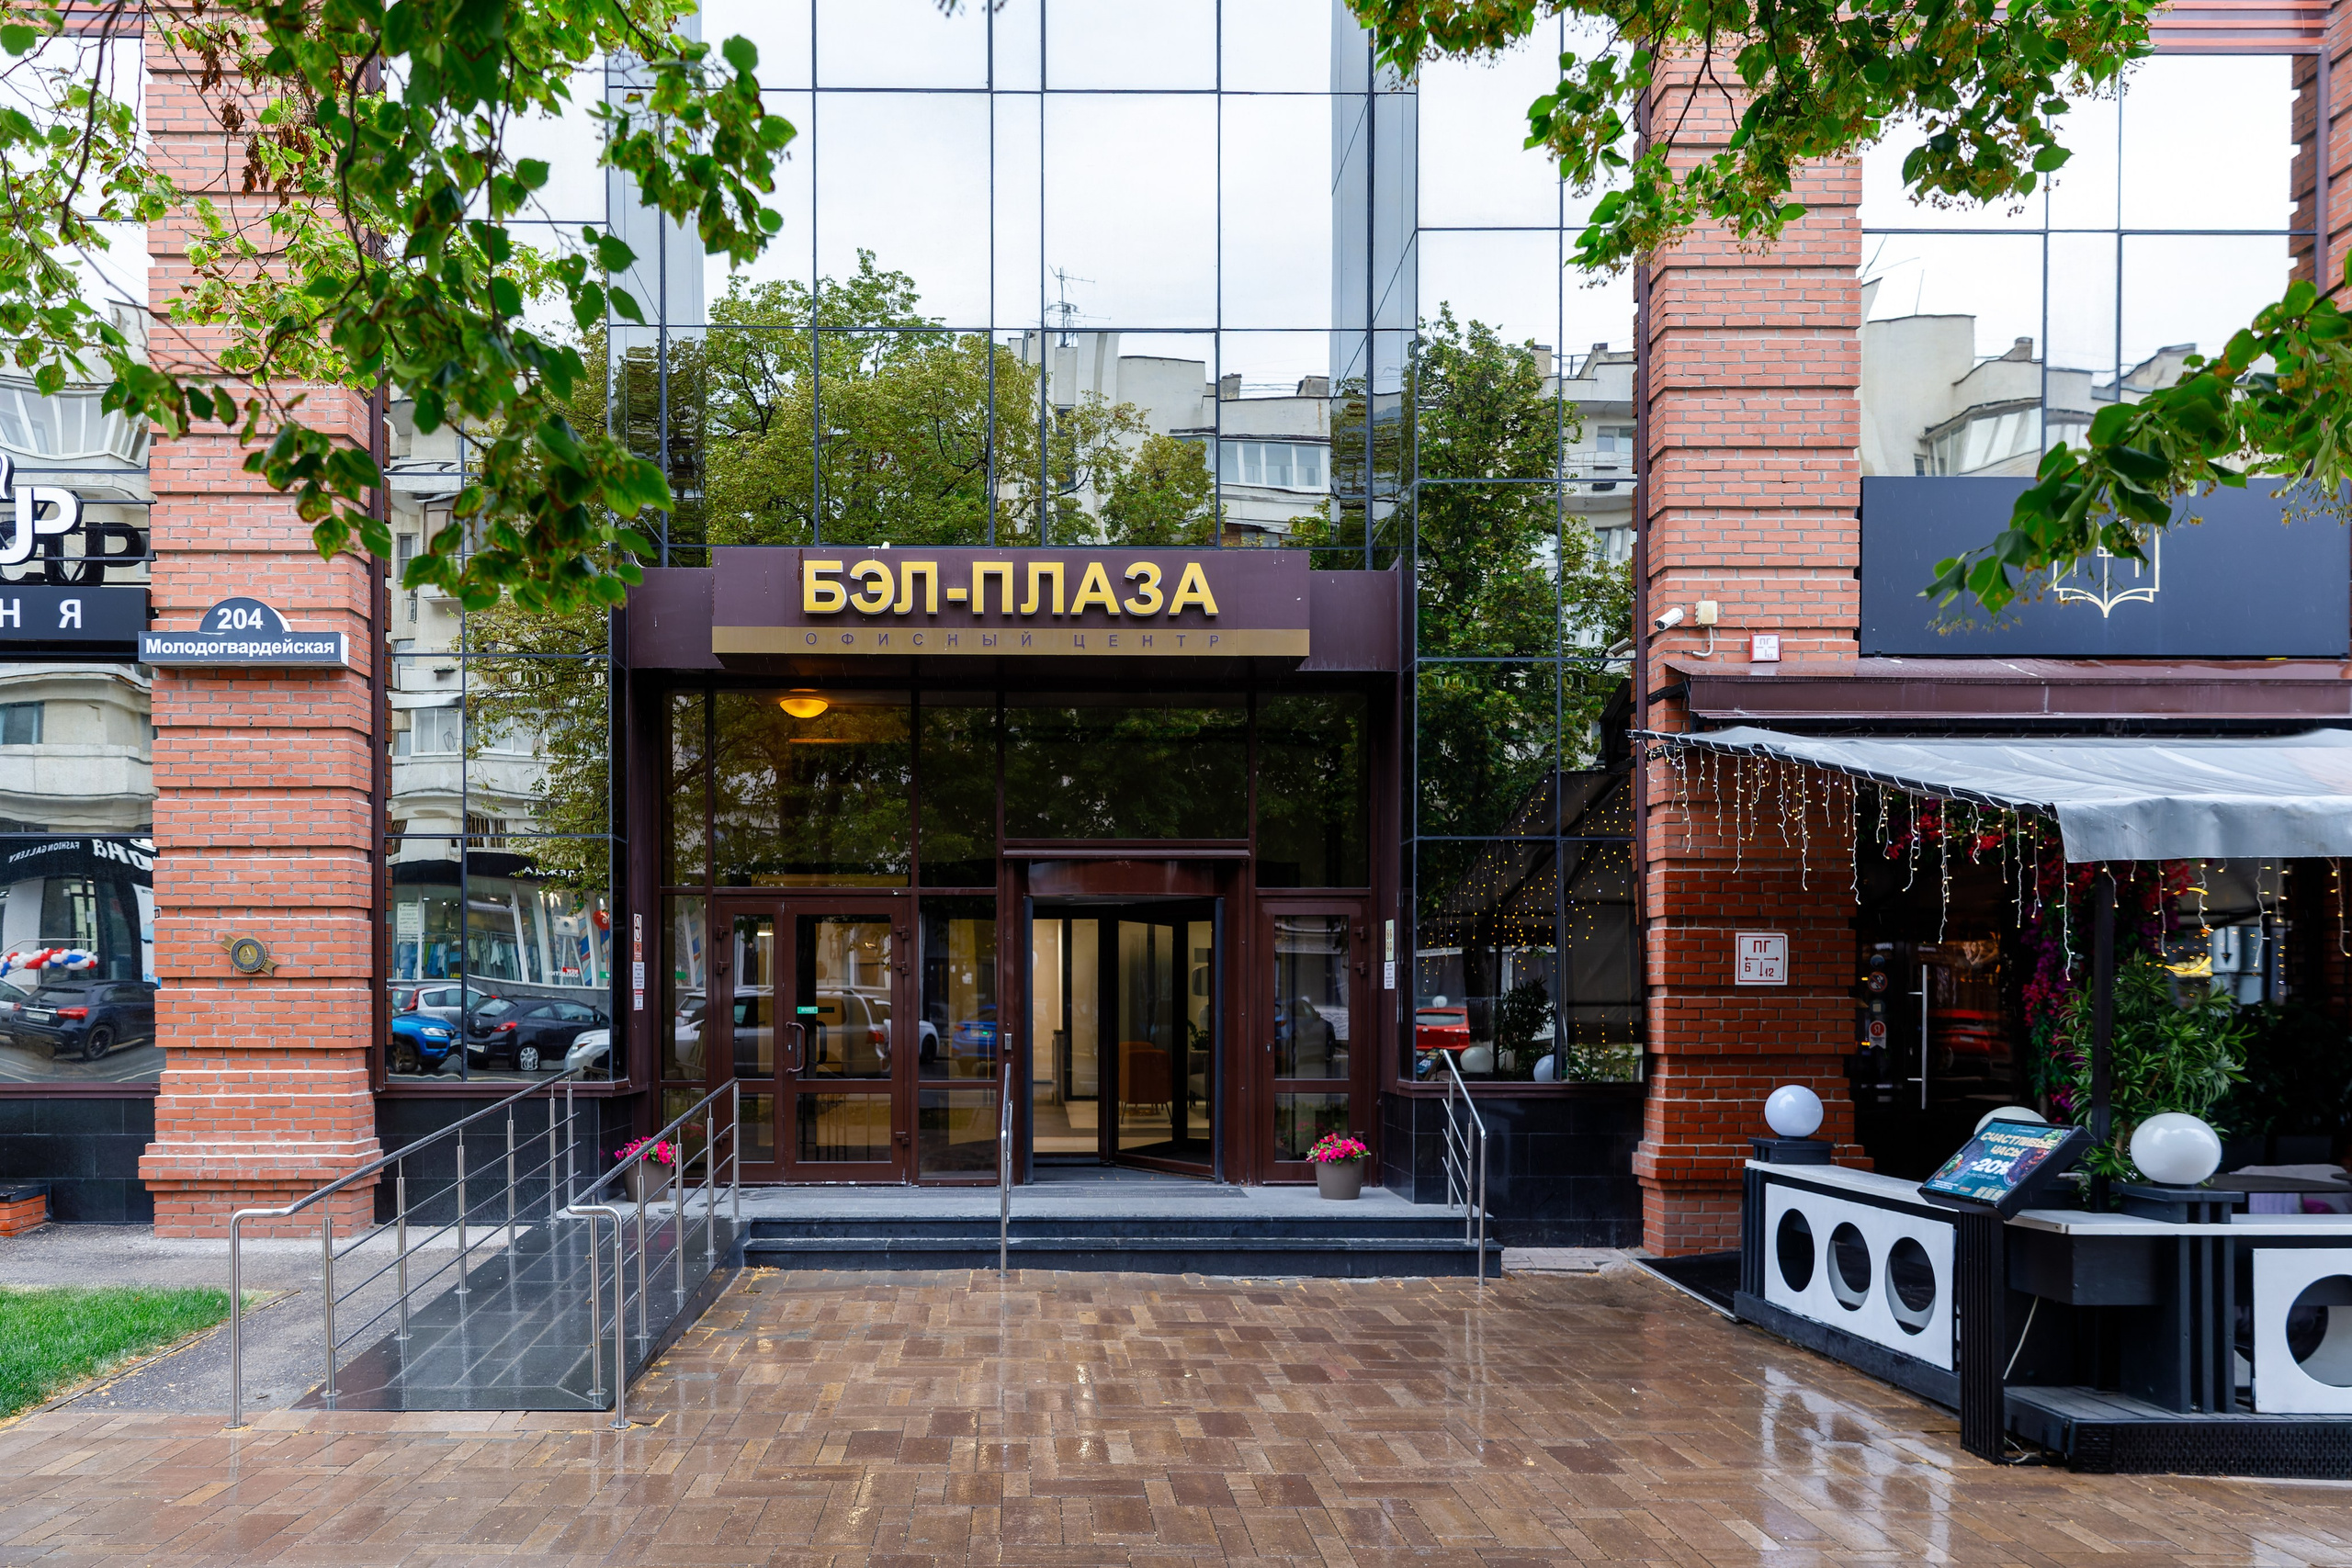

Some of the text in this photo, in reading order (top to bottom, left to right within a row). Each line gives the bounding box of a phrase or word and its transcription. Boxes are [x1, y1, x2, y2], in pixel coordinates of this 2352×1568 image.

[802, 559, 1219, 616] БЭЛ-ПЛАЗА
[217, 607, 263, 629] 204
[145, 638, 334, 657] Молодогвардейская
[806, 631, 1220, 649] ОФИСНЫЙ ЦЕНТР
[1753, 941, 1770, 953] ПГ
[1765, 967, 1774, 976] 12
[1980, 1132, 2058, 1149] СЧАСТЛИВЫЕ
[1990, 1145, 2025, 1157] ЧАСЫ
[1970, 1158, 2016, 1175] -20%
